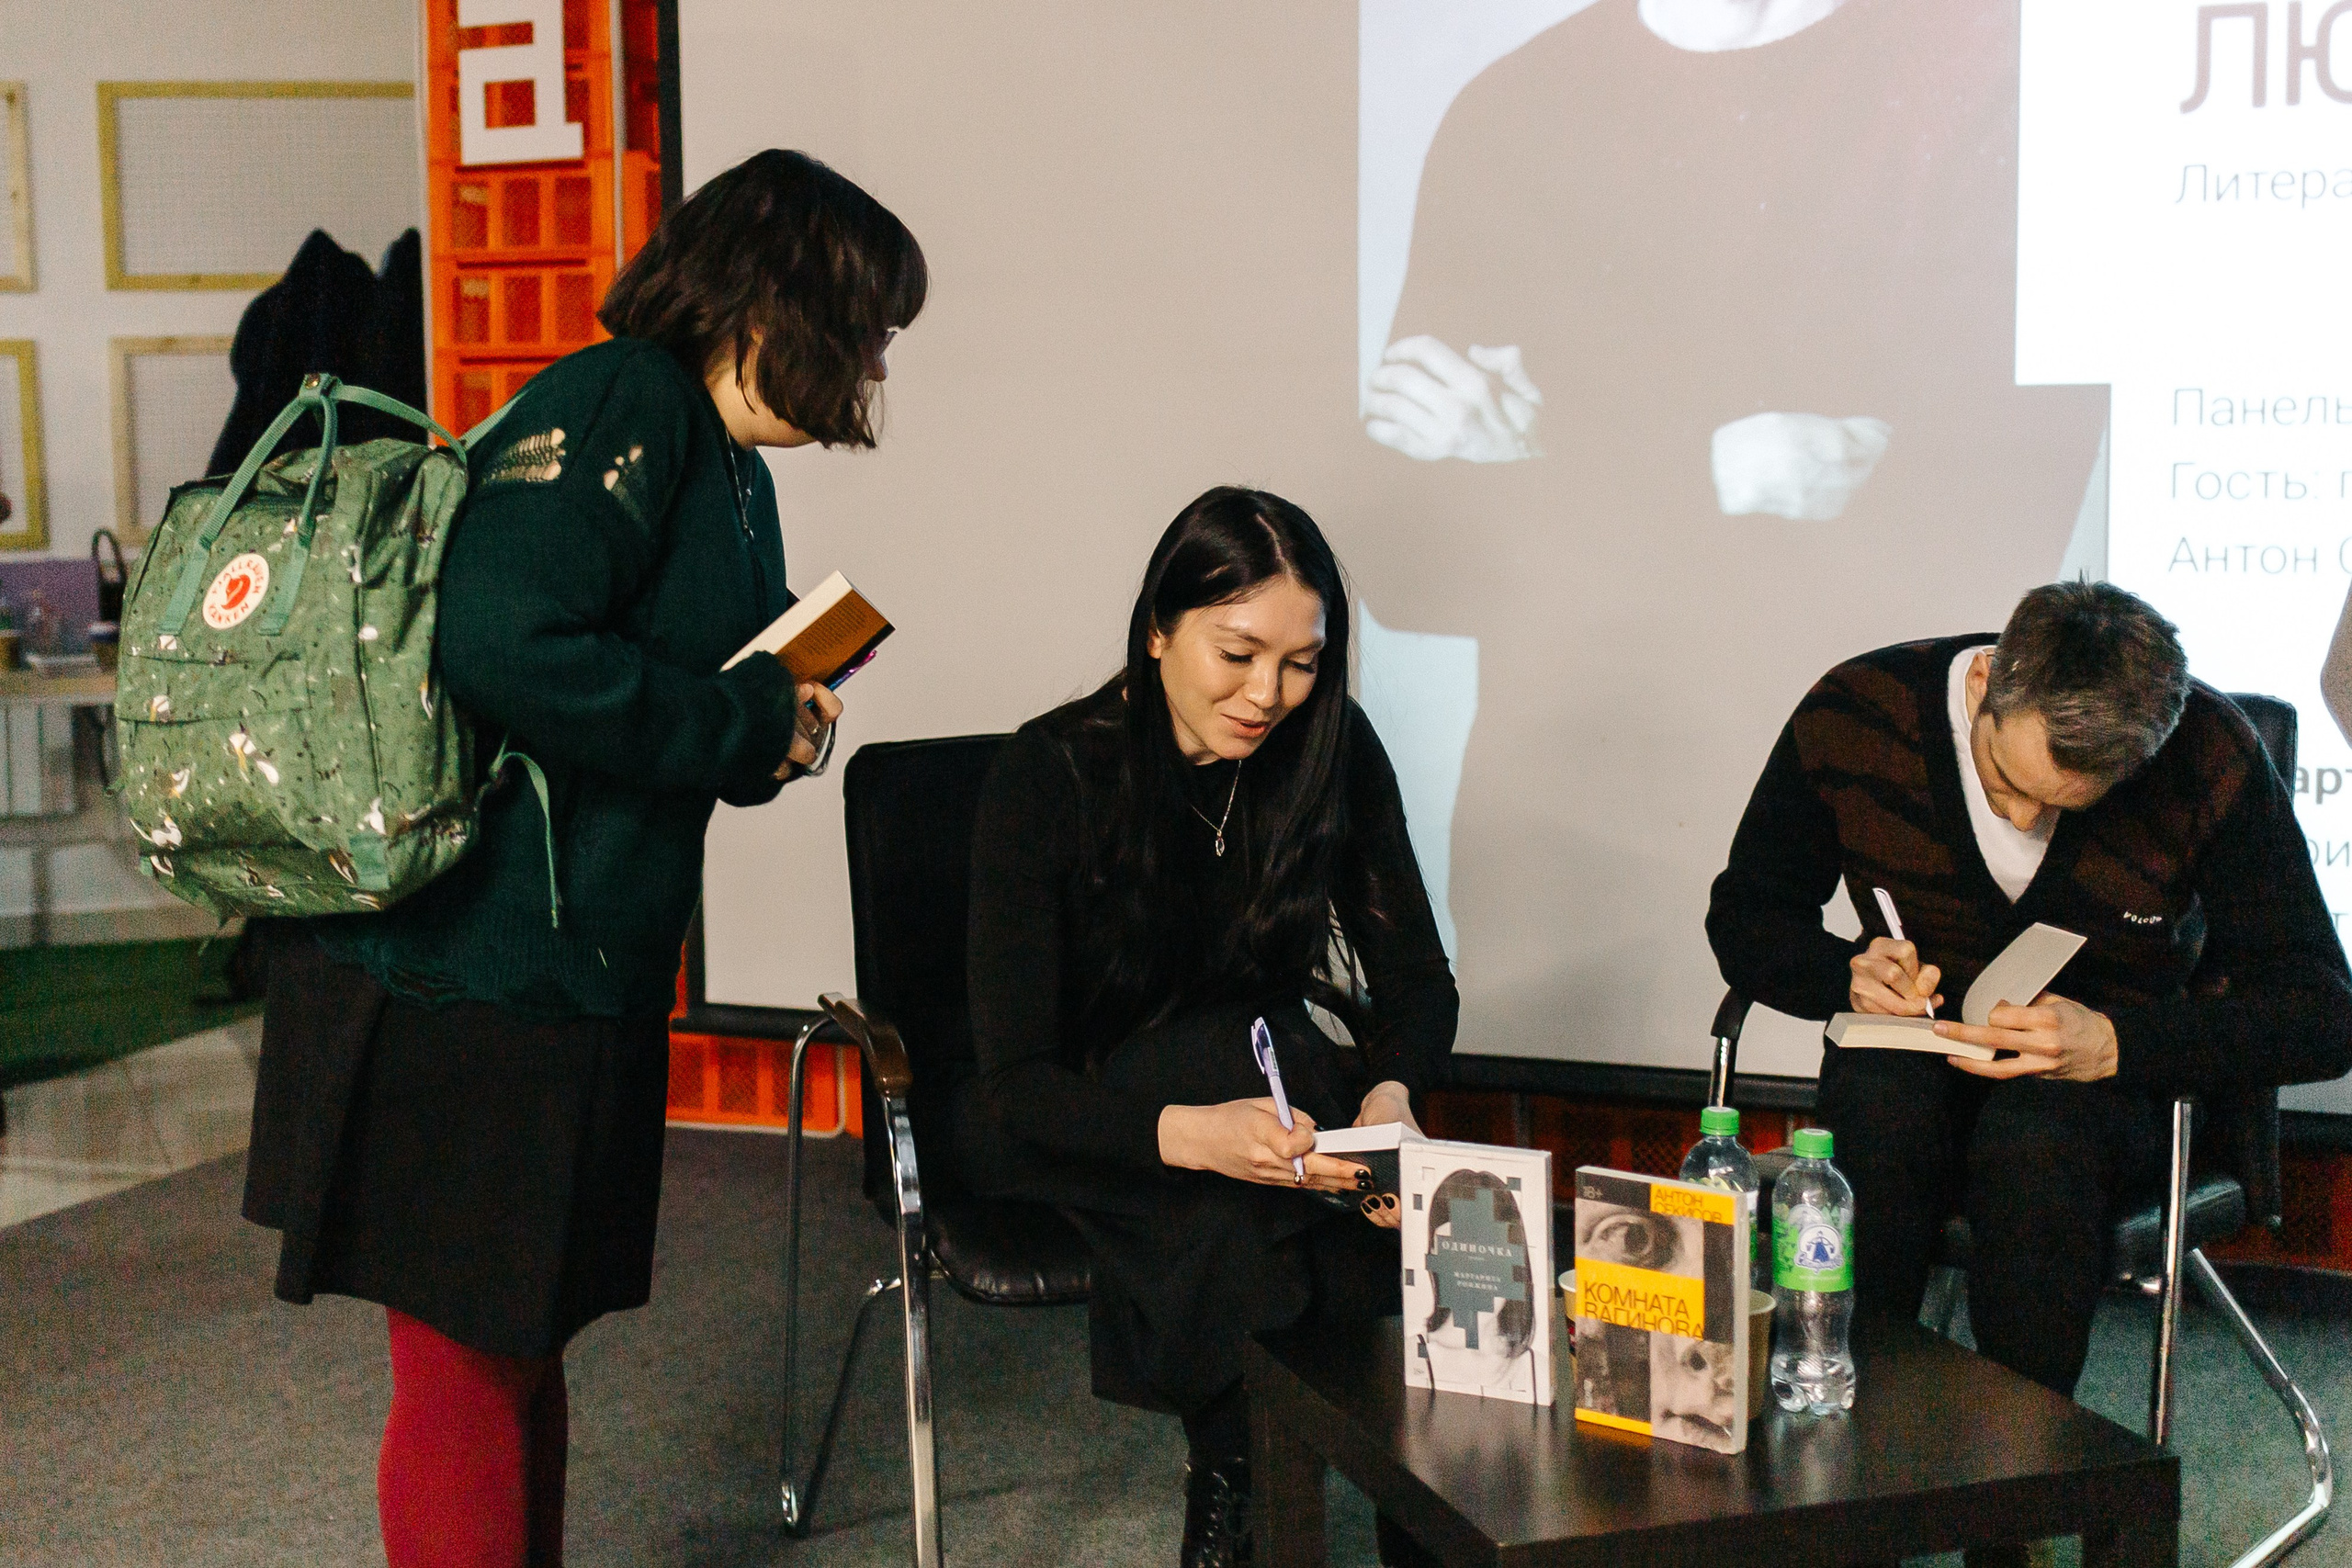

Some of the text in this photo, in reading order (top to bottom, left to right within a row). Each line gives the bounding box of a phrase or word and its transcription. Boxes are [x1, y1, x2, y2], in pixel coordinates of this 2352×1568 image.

[2175, 164, 2352, 209] Литера
[2173, 388, 2352, 426] Панель
[2172, 462, 2319, 501] Гость:
[2168, 536, 2318, 574] Антон
[2295, 766, 2352, 805] ар
[1655, 1189, 1703, 1208] АНТОН
[1442, 1240, 1513, 1258] ОДИНОЧКА
[1584, 1280, 1690, 1319] КОМНАТА
[1584, 1302, 1704, 1339] ВАГИНОВА
